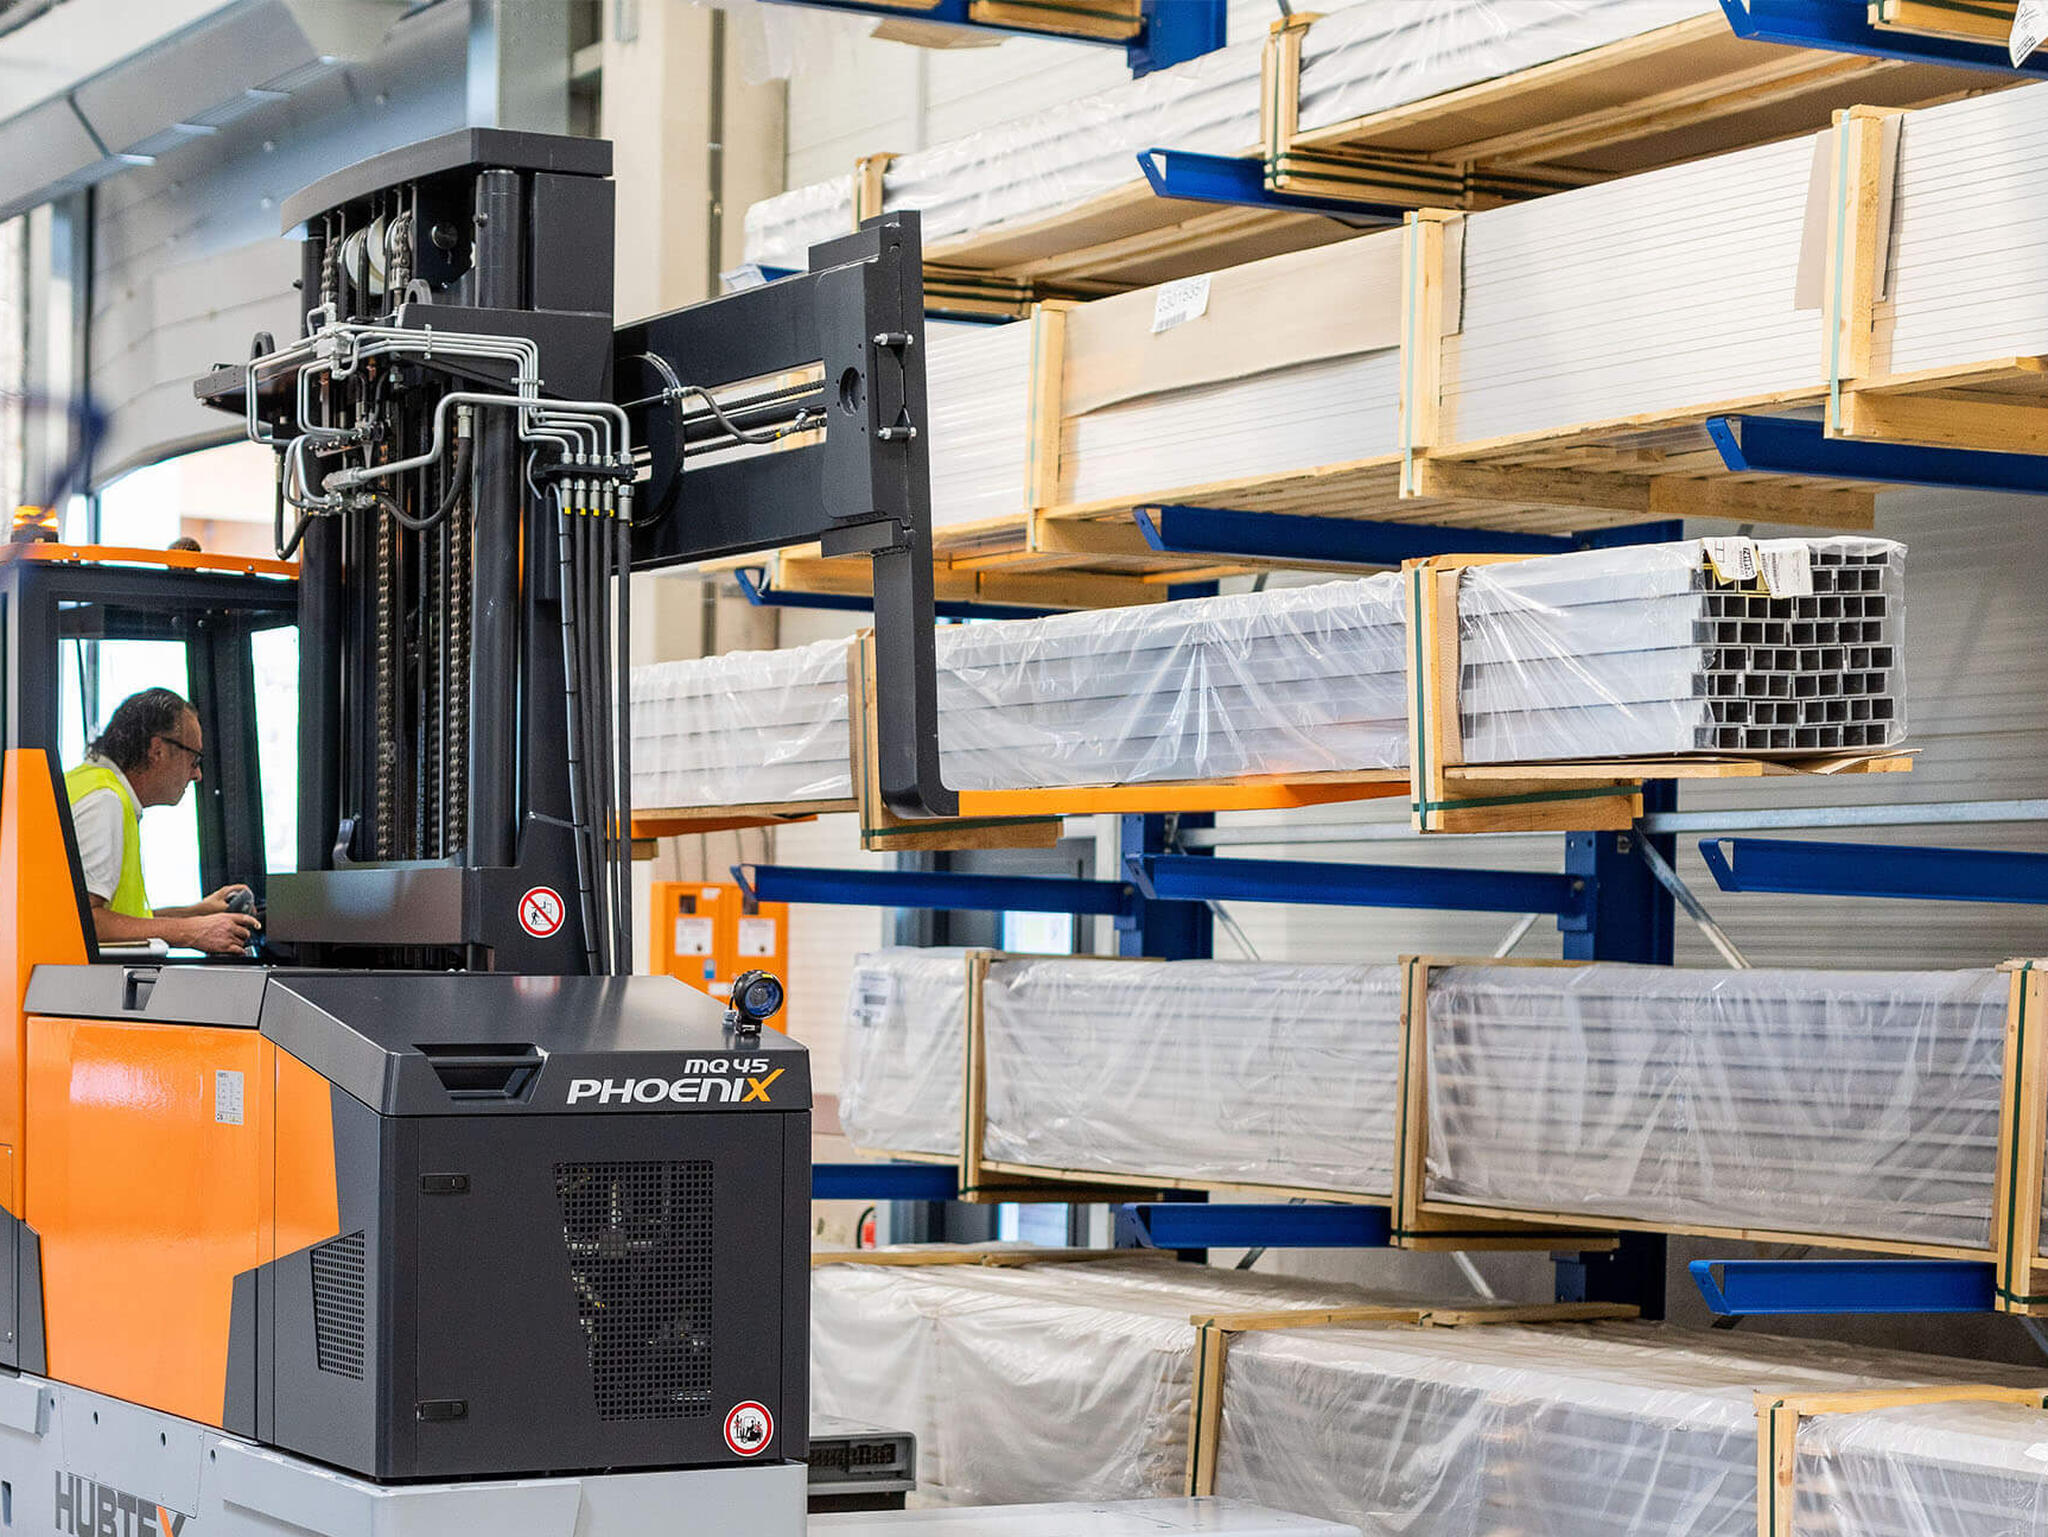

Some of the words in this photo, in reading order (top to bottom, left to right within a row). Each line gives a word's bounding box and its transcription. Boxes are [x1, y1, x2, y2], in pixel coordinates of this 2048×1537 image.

[684, 1058, 728, 1074] MQ
[732, 1058, 770, 1073] 45
[566, 1068, 786, 1105] PHOENIX
